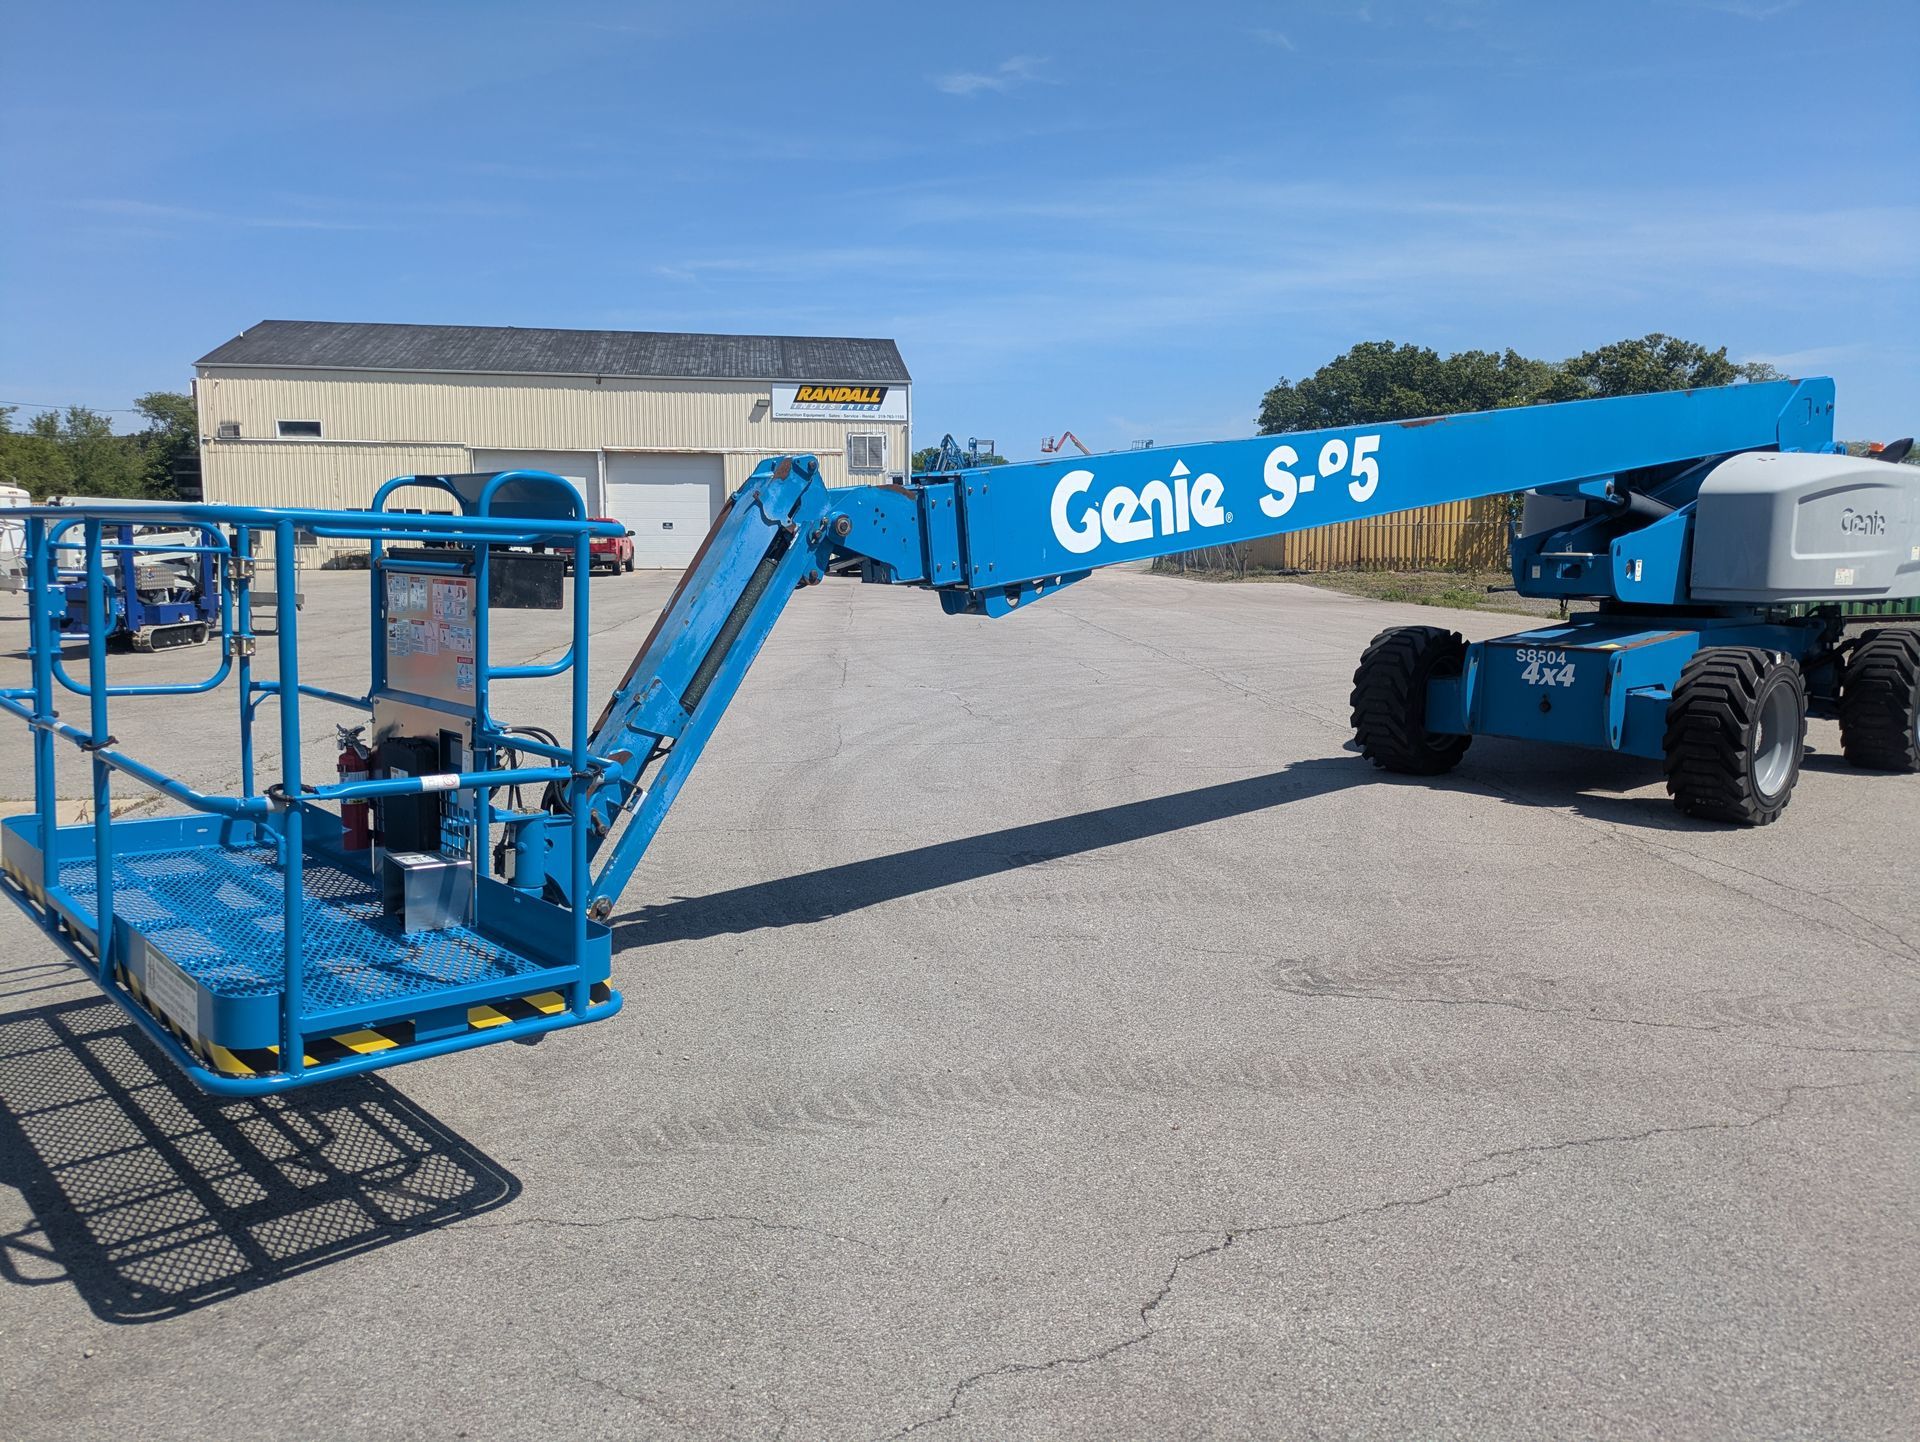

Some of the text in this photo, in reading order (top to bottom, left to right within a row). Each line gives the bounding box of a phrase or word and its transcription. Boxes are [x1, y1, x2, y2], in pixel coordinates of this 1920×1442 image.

[796, 386, 880, 402] RANDALL
[793, 403, 880, 411] INDUSTRIES
[1051, 459, 1224, 554] Genie
[1841, 508, 1886, 535] Genie
[1516, 649, 1567, 666] S8504
[1521, 662, 1576, 687] 4x4
